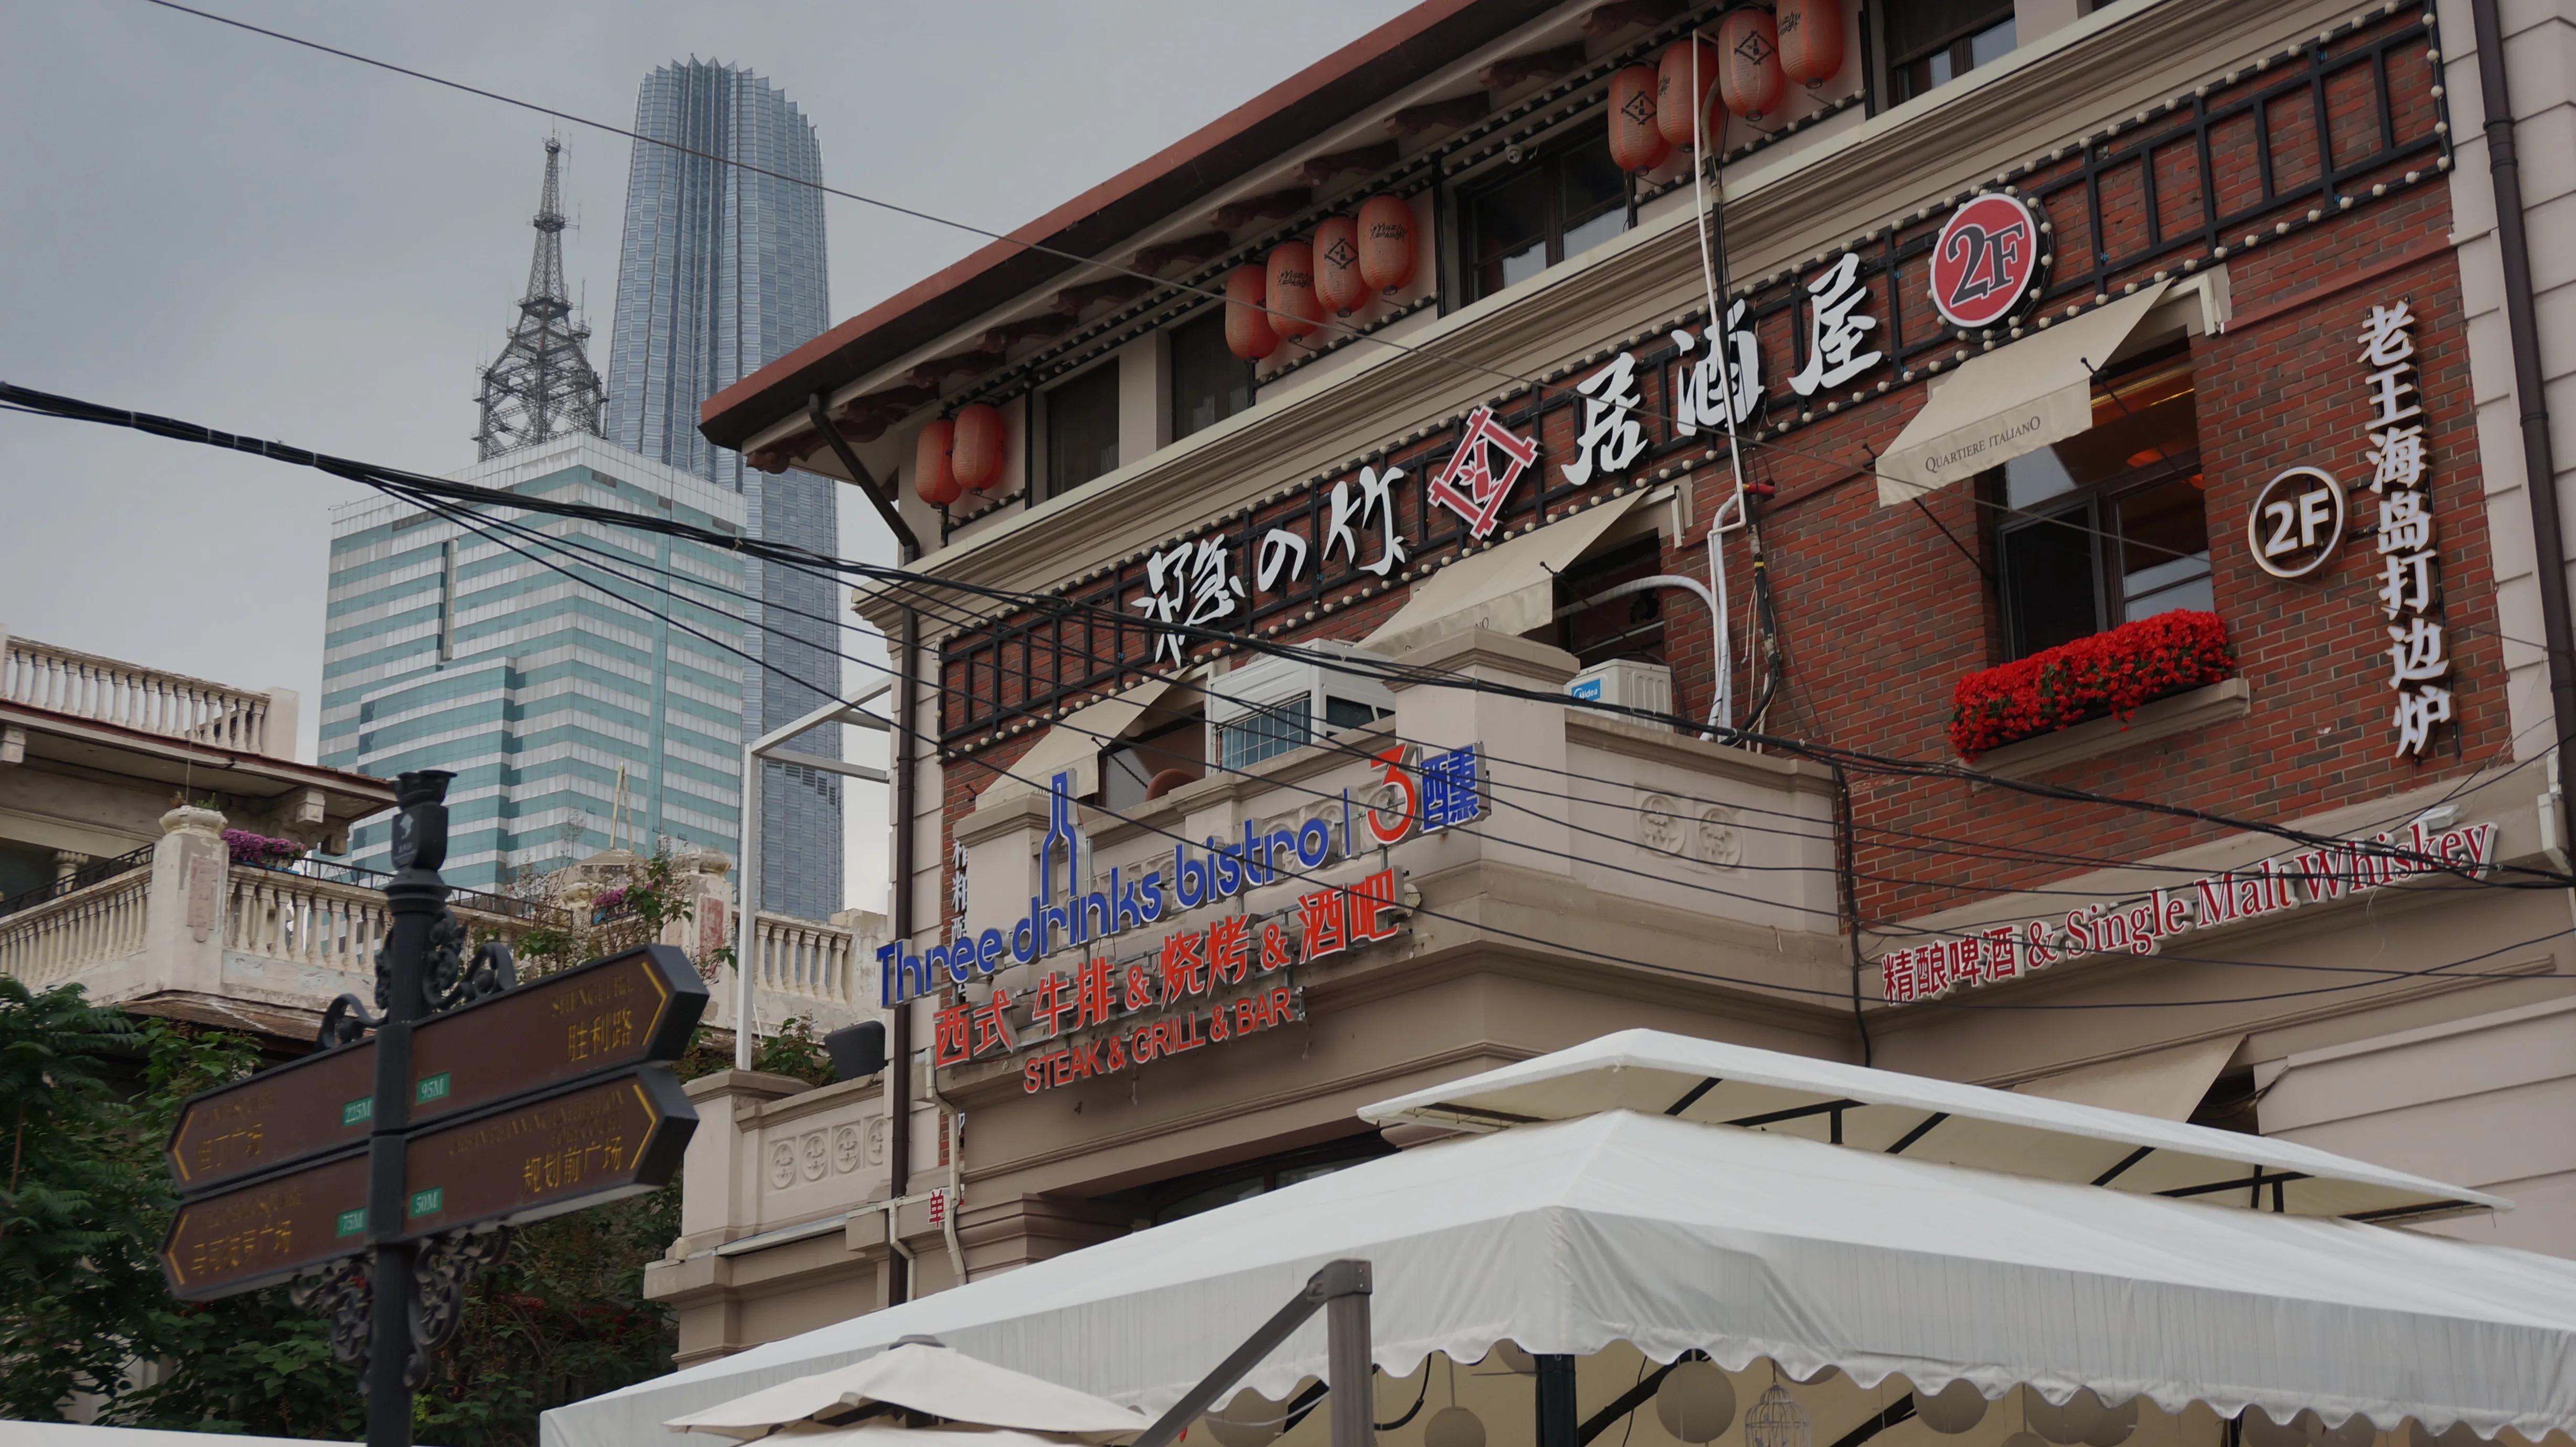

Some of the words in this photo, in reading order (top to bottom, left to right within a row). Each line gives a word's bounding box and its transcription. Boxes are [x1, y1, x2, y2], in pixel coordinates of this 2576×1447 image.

[1946, 221, 2024, 308] 2F
[1925, 440, 1985, 473] QUARTIERE
[1989, 416, 2041, 448] ITALIANO
[2265, 487, 2329, 558] 2F
[2357, 300, 2450, 759] 老王海岛打边炉
[1578, 688, 1598, 699] Midea
[876, 928, 1002, 1009] Three
[1012, 866, 1162, 965] drinks
[1174, 817, 1329, 909] bistro
[1882, 925, 2016, 1006] 精酿啤酒
[2026, 920, 2058, 969] &
[2066, 886, 2186, 956] Single
[2194, 857, 2292, 929] Malt
[2294, 822, 2493, 903] Whiskey
[933, 988, 1013, 1070] 西式
[1032, 956, 1116, 1039] 牛排
[1125, 966, 1153, 1011] &
[1159, 913, 1250, 1012] 烧烤
[1260, 923, 1291, 971] &
[1297, 867, 1400, 965] 酒吧
[567, 1007, 633, 1064] 胜利路
[1023, 1040, 1103, 1094] STEAK
[1107, 1035, 1127, 1072] &
[1131, 1012, 1206, 1064] GRILL
[1210, 1005, 1230, 1043] &
[1235, 987, 1293, 1037] BAR
[346, 1100, 371, 1123] 225M
[422, 1078, 445, 1099] 95M
[416, 1191, 438, 1213] 50M
